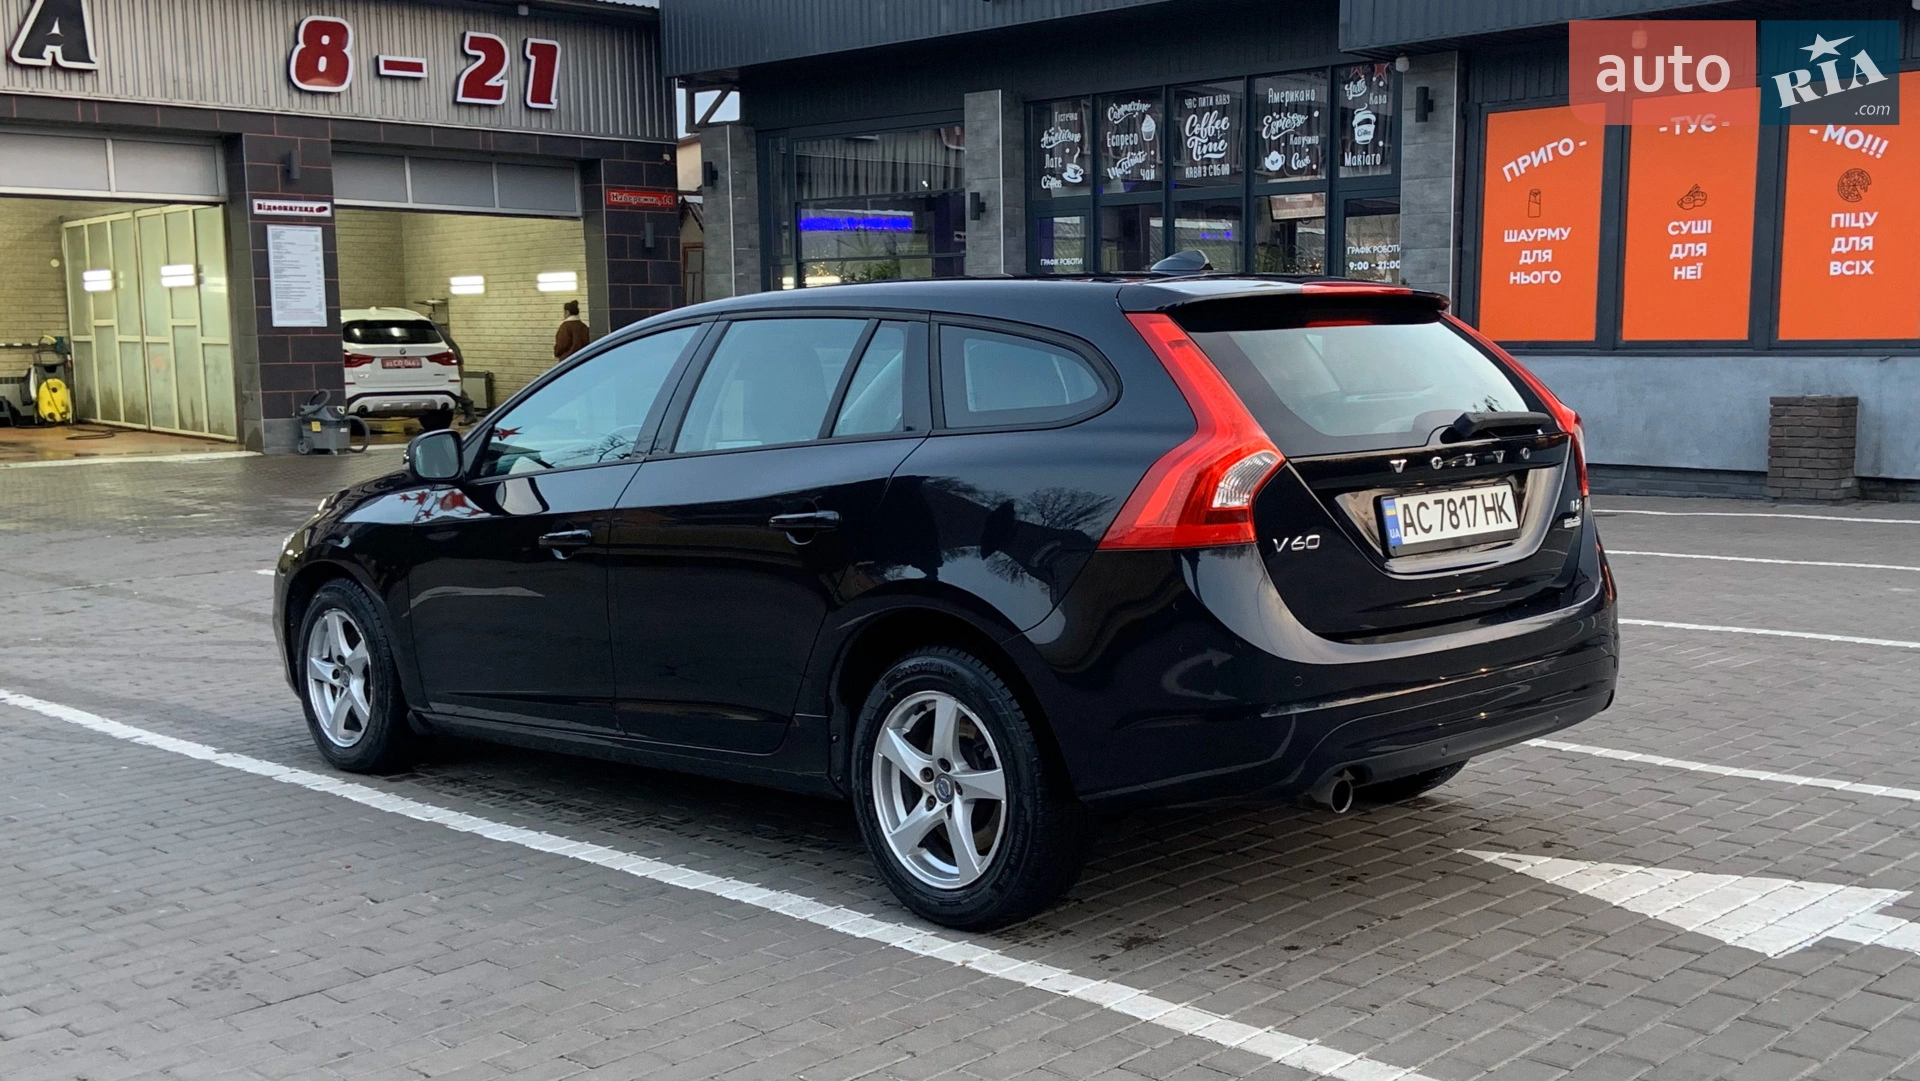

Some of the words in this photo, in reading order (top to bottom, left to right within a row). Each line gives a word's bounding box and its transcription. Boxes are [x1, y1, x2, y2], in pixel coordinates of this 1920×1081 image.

[290, 15, 353, 92] 8
[456, 31, 562, 110] 21
[1268, 88, 1316, 107] Американо
[1185, 110, 1230, 138] Coffee
[1261, 112, 1309, 140] Espresso
[1106, 131, 1139, 150] Еспресо
[1187, 135, 1228, 161] Time
[1289, 133, 1320, 148] Капучино
[1044, 153, 1063, 169] Лате
[1344, 151, 1381, 167] Макіато
[1667, 220, 1712, 236] СУШІ
[1830, 211, 1878, 229] ПІЦУ
[1504, 227, 1571, 243] ШАУРМУ
[1669, 243, 1707, 260] ДЛЯ
[1830, 236, 1874, 254] ДЛЯ
[1348, 261, 1369, 271] 9:00
[1377, 260, 1401, 270] 21:00
[1519, 249, 1552, 265] ДЛЯ
[1673, 262, 1702, 280] НЕЇ
[1829, 259, 1875, 276] ВСІХ
[1509, 270, 1562, 285] НЬОГО
[1389, 447, 1532, 474] VOLVO
[1402, 501, 1433, 537] AC
[1433, 494, 1478, 532] 7817
[1481, 491, 1513, 526] HK
[1389, 529, 1401, 539] UA
[1272, 534, 1321, 553] V60
